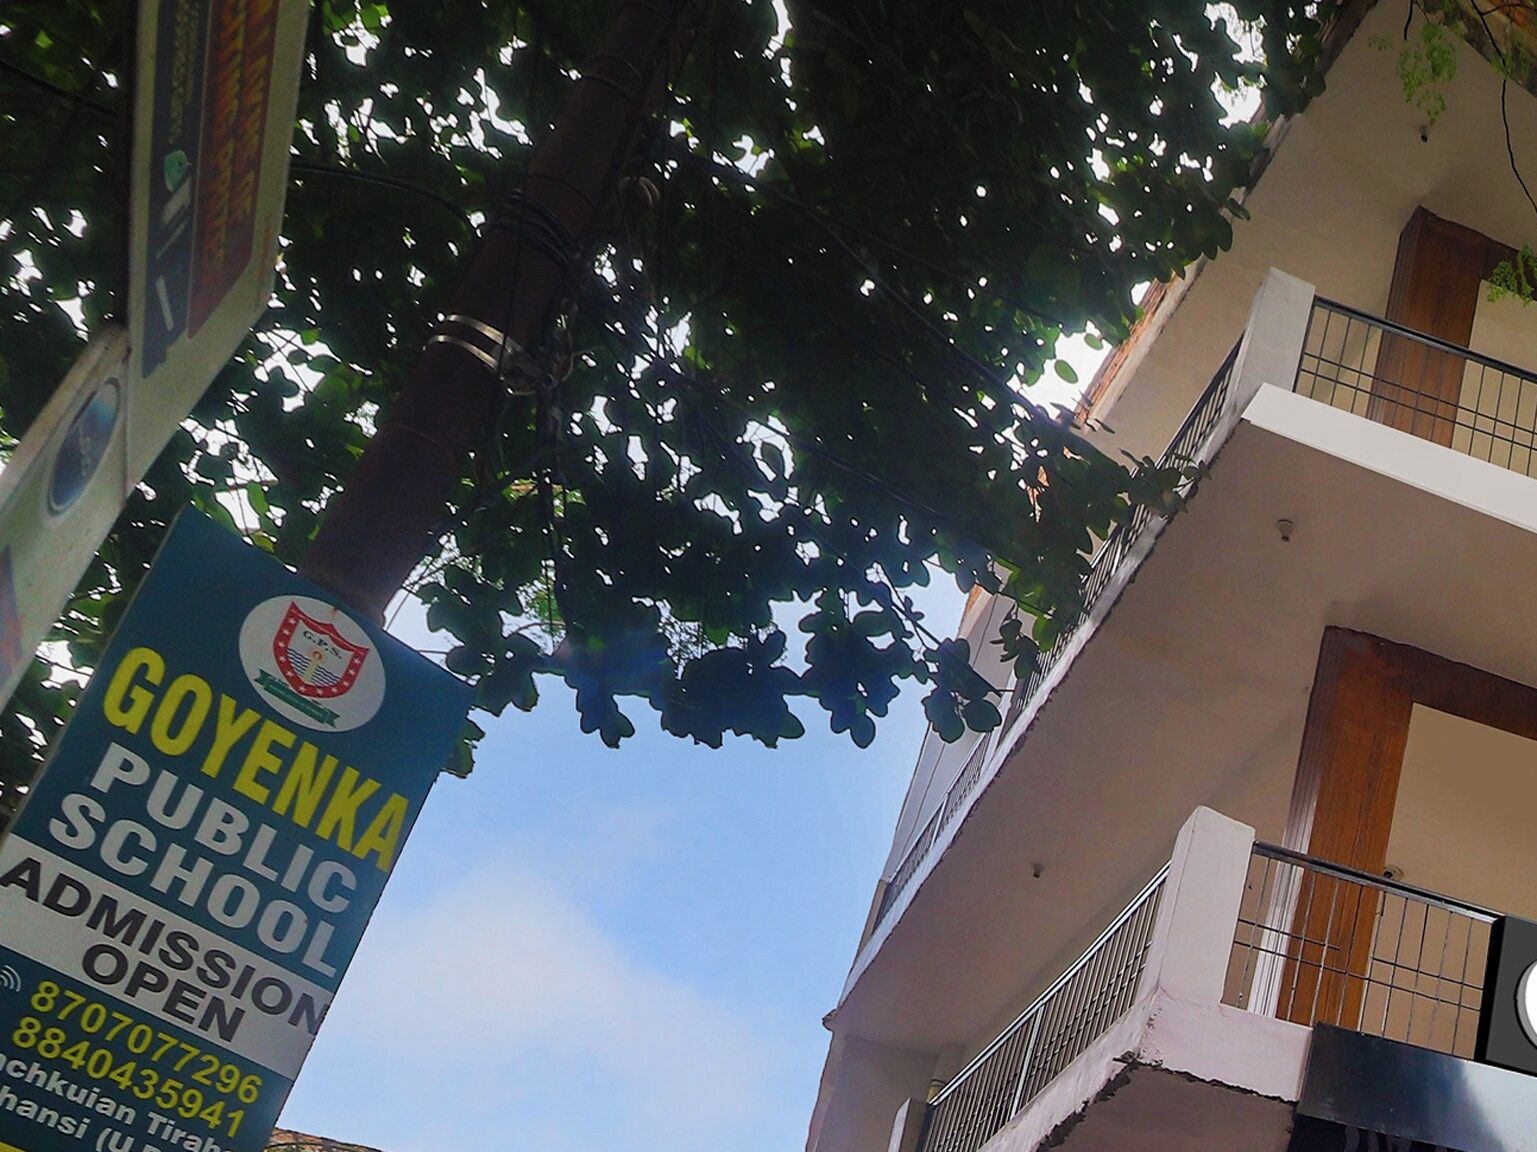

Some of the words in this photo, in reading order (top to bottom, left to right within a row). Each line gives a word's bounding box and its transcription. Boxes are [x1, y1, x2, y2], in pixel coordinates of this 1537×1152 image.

[90, 743, 358, 914] PUBLIC
[103, 647, 409, 873] GOYENKA
[2, 856, 330, 1037] ADMISSION
[49, 793, 340, 980] SCHOOL
[30, 980, 262, 1103] 8707077296
[81, 943, 245, 1043] OPEN
[0, 1083, 91, 1140] hansi
[12, 1016, 244, 1138] 8840435941
